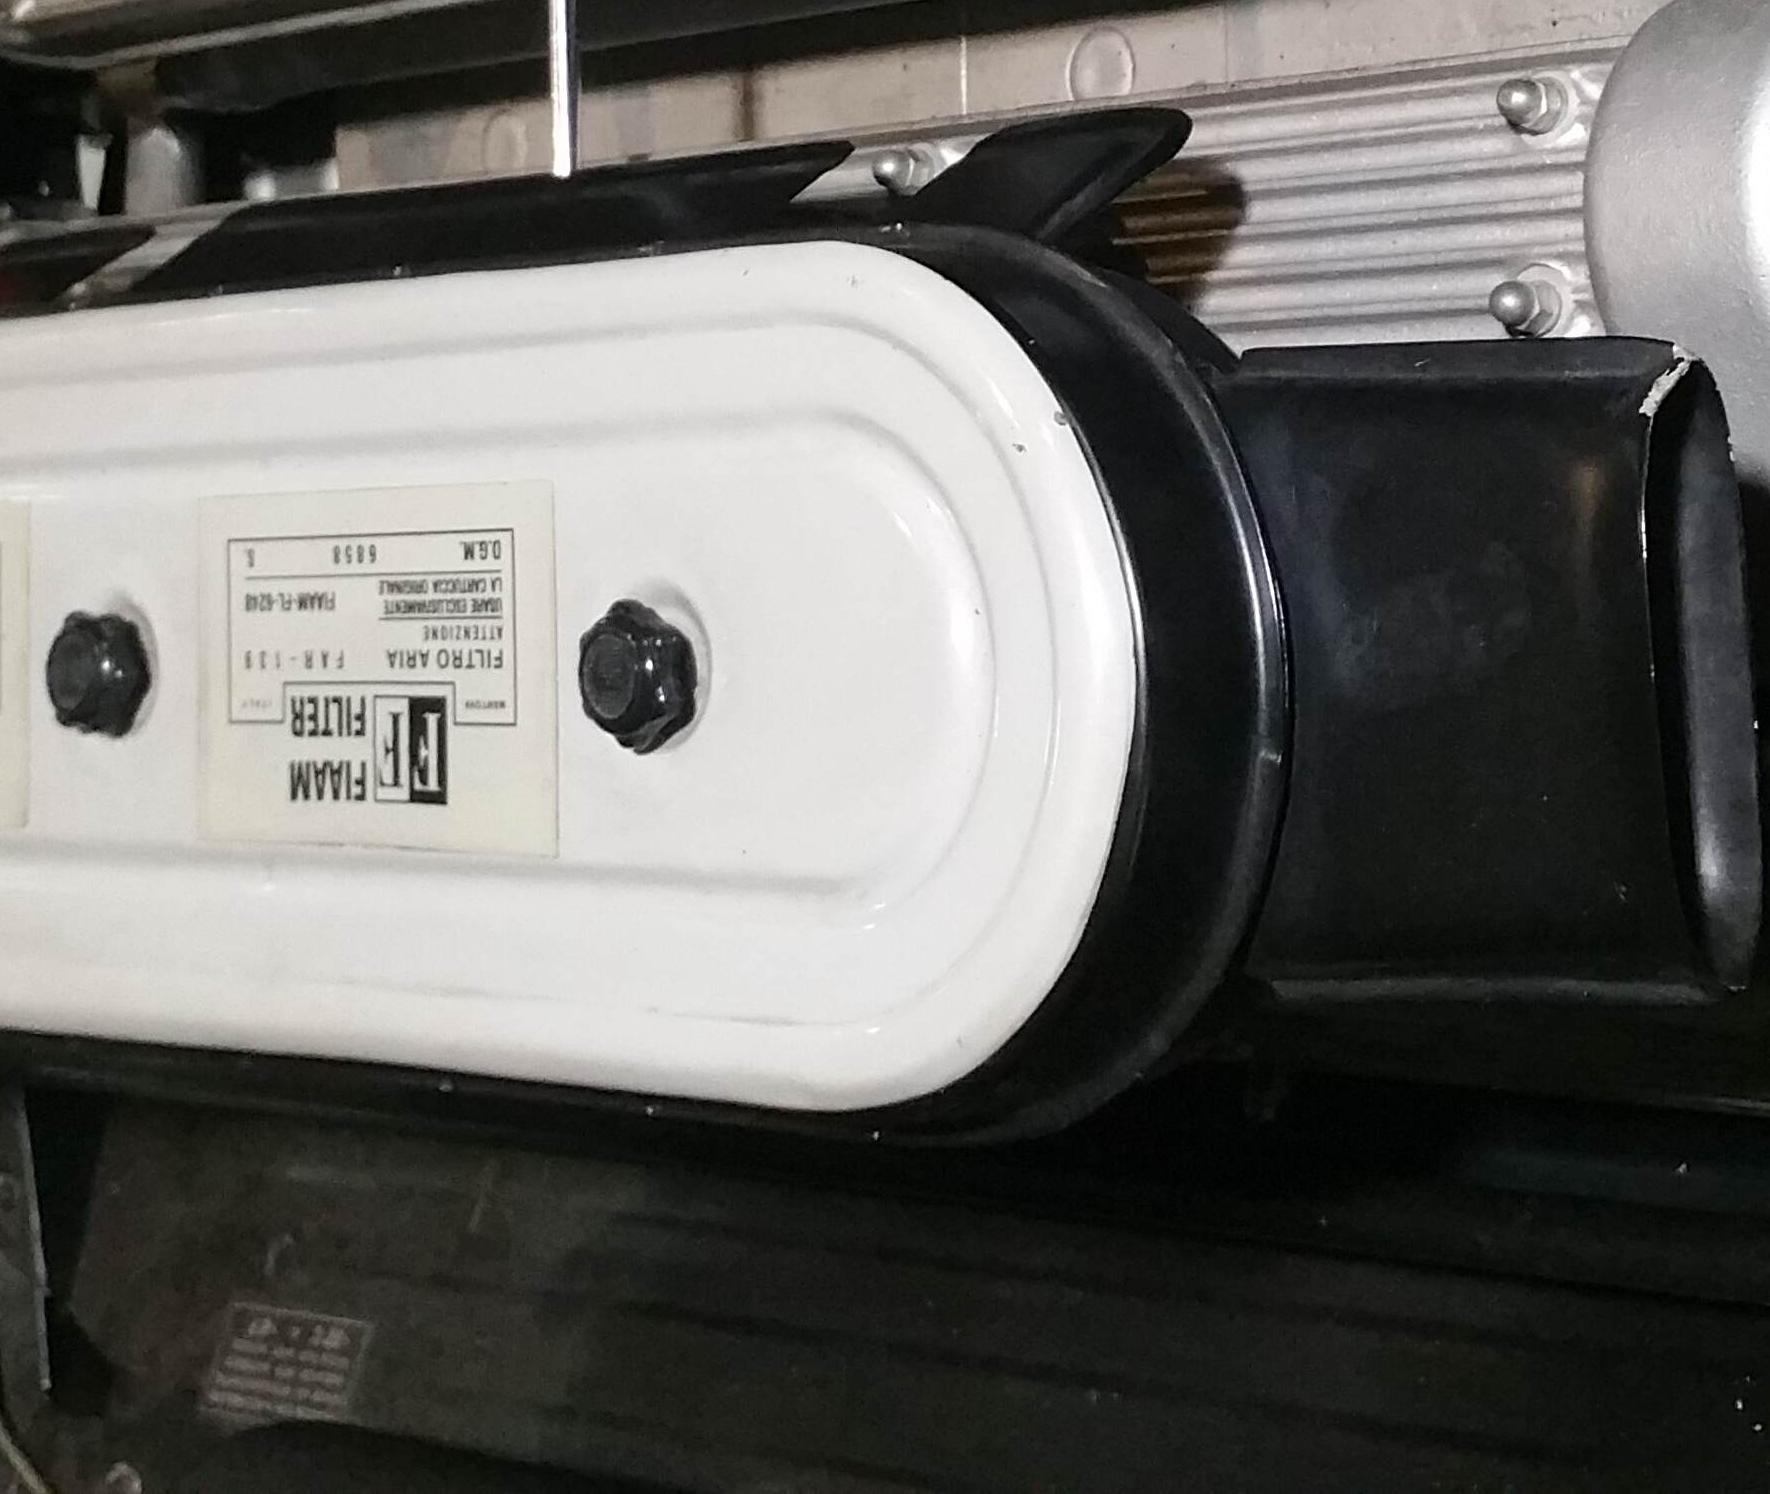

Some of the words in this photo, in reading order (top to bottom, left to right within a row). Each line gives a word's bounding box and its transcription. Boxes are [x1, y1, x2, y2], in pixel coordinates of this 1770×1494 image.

[379, 579, 429, 596] ORIGINALE
[432, 578, 487, 594] CARTUCCIA
[491, 577, 502, 593] LA
[471, 597, 503, 614] USARE
[422, 625, 504, 641] ATTENZIONE
[386, 649, 430, 669] ARIA
[437, 648, 504, 669] FILTRO
[290, 695, 367, 738] FILTER
[288, 759, 367, 802] FIAAM
